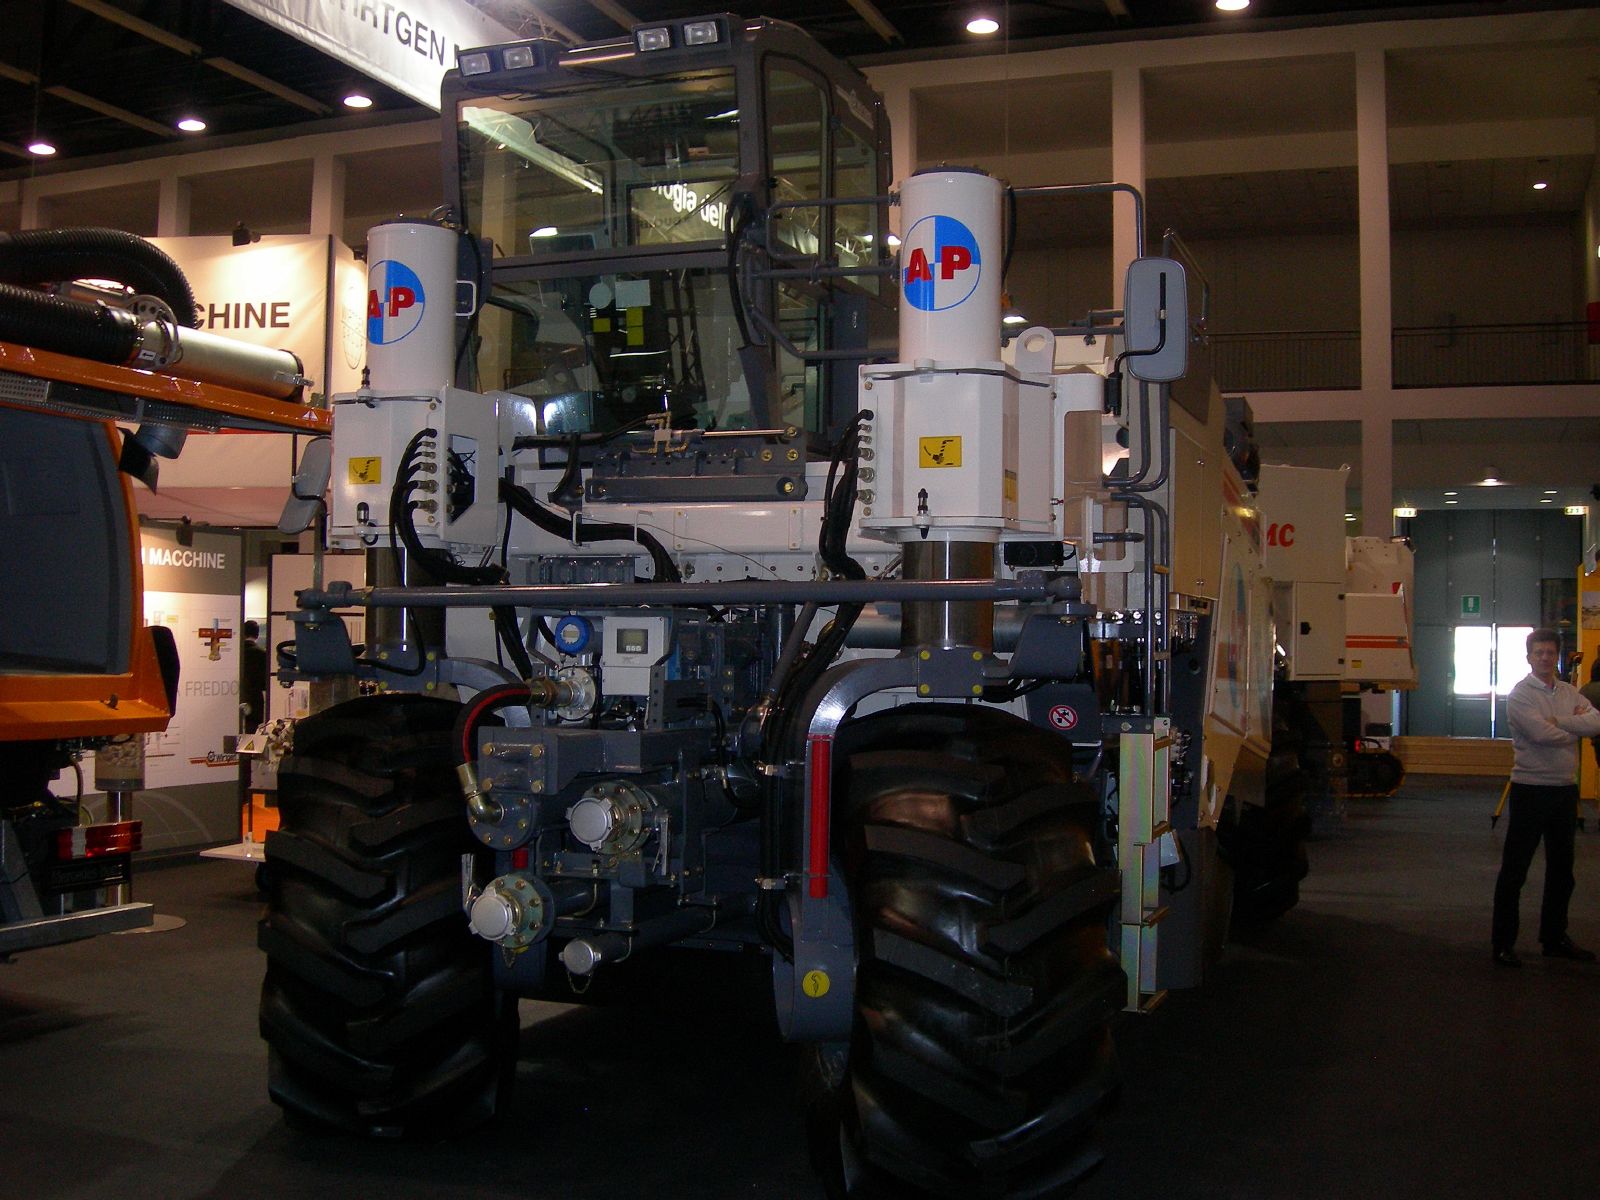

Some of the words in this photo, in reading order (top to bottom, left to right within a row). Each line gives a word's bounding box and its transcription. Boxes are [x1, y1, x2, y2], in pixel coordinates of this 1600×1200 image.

[905, 245, 972, 286] AP
[367, 286, 416, 319] AP
[148, 547, 226, 570] MACCHINE
